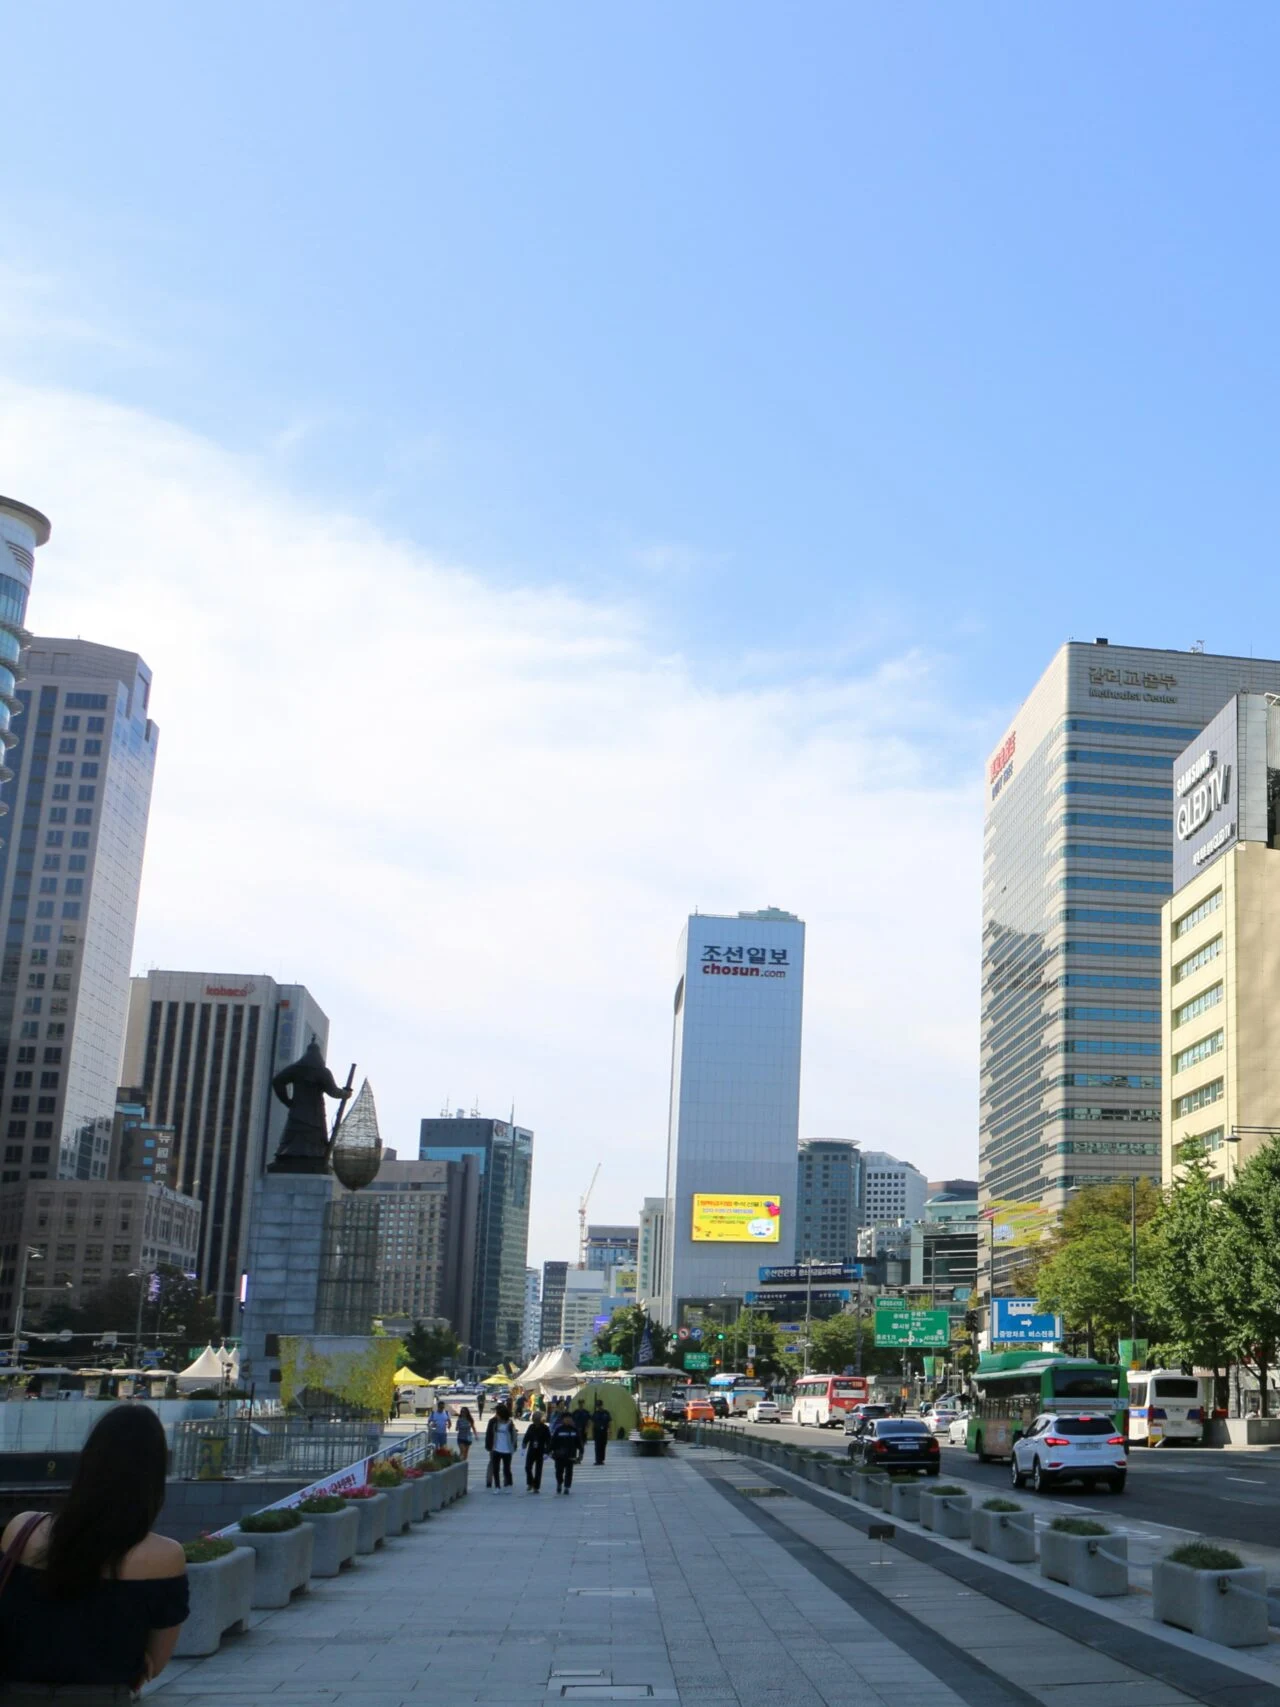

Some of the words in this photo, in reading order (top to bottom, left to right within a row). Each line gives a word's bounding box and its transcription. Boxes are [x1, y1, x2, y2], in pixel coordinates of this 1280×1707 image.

[1089, 687, 1140, 702] Methodist
[1143, 692, 1178, 704] Center
[1177, 784, 1209, 840] QLED
[1209, 763, 1226, 811] TV
[701, 945, 790, 965] 조선일보
[702, 963, 786, 978] chosun.com
[205, 984, 247, 997] kobaco
